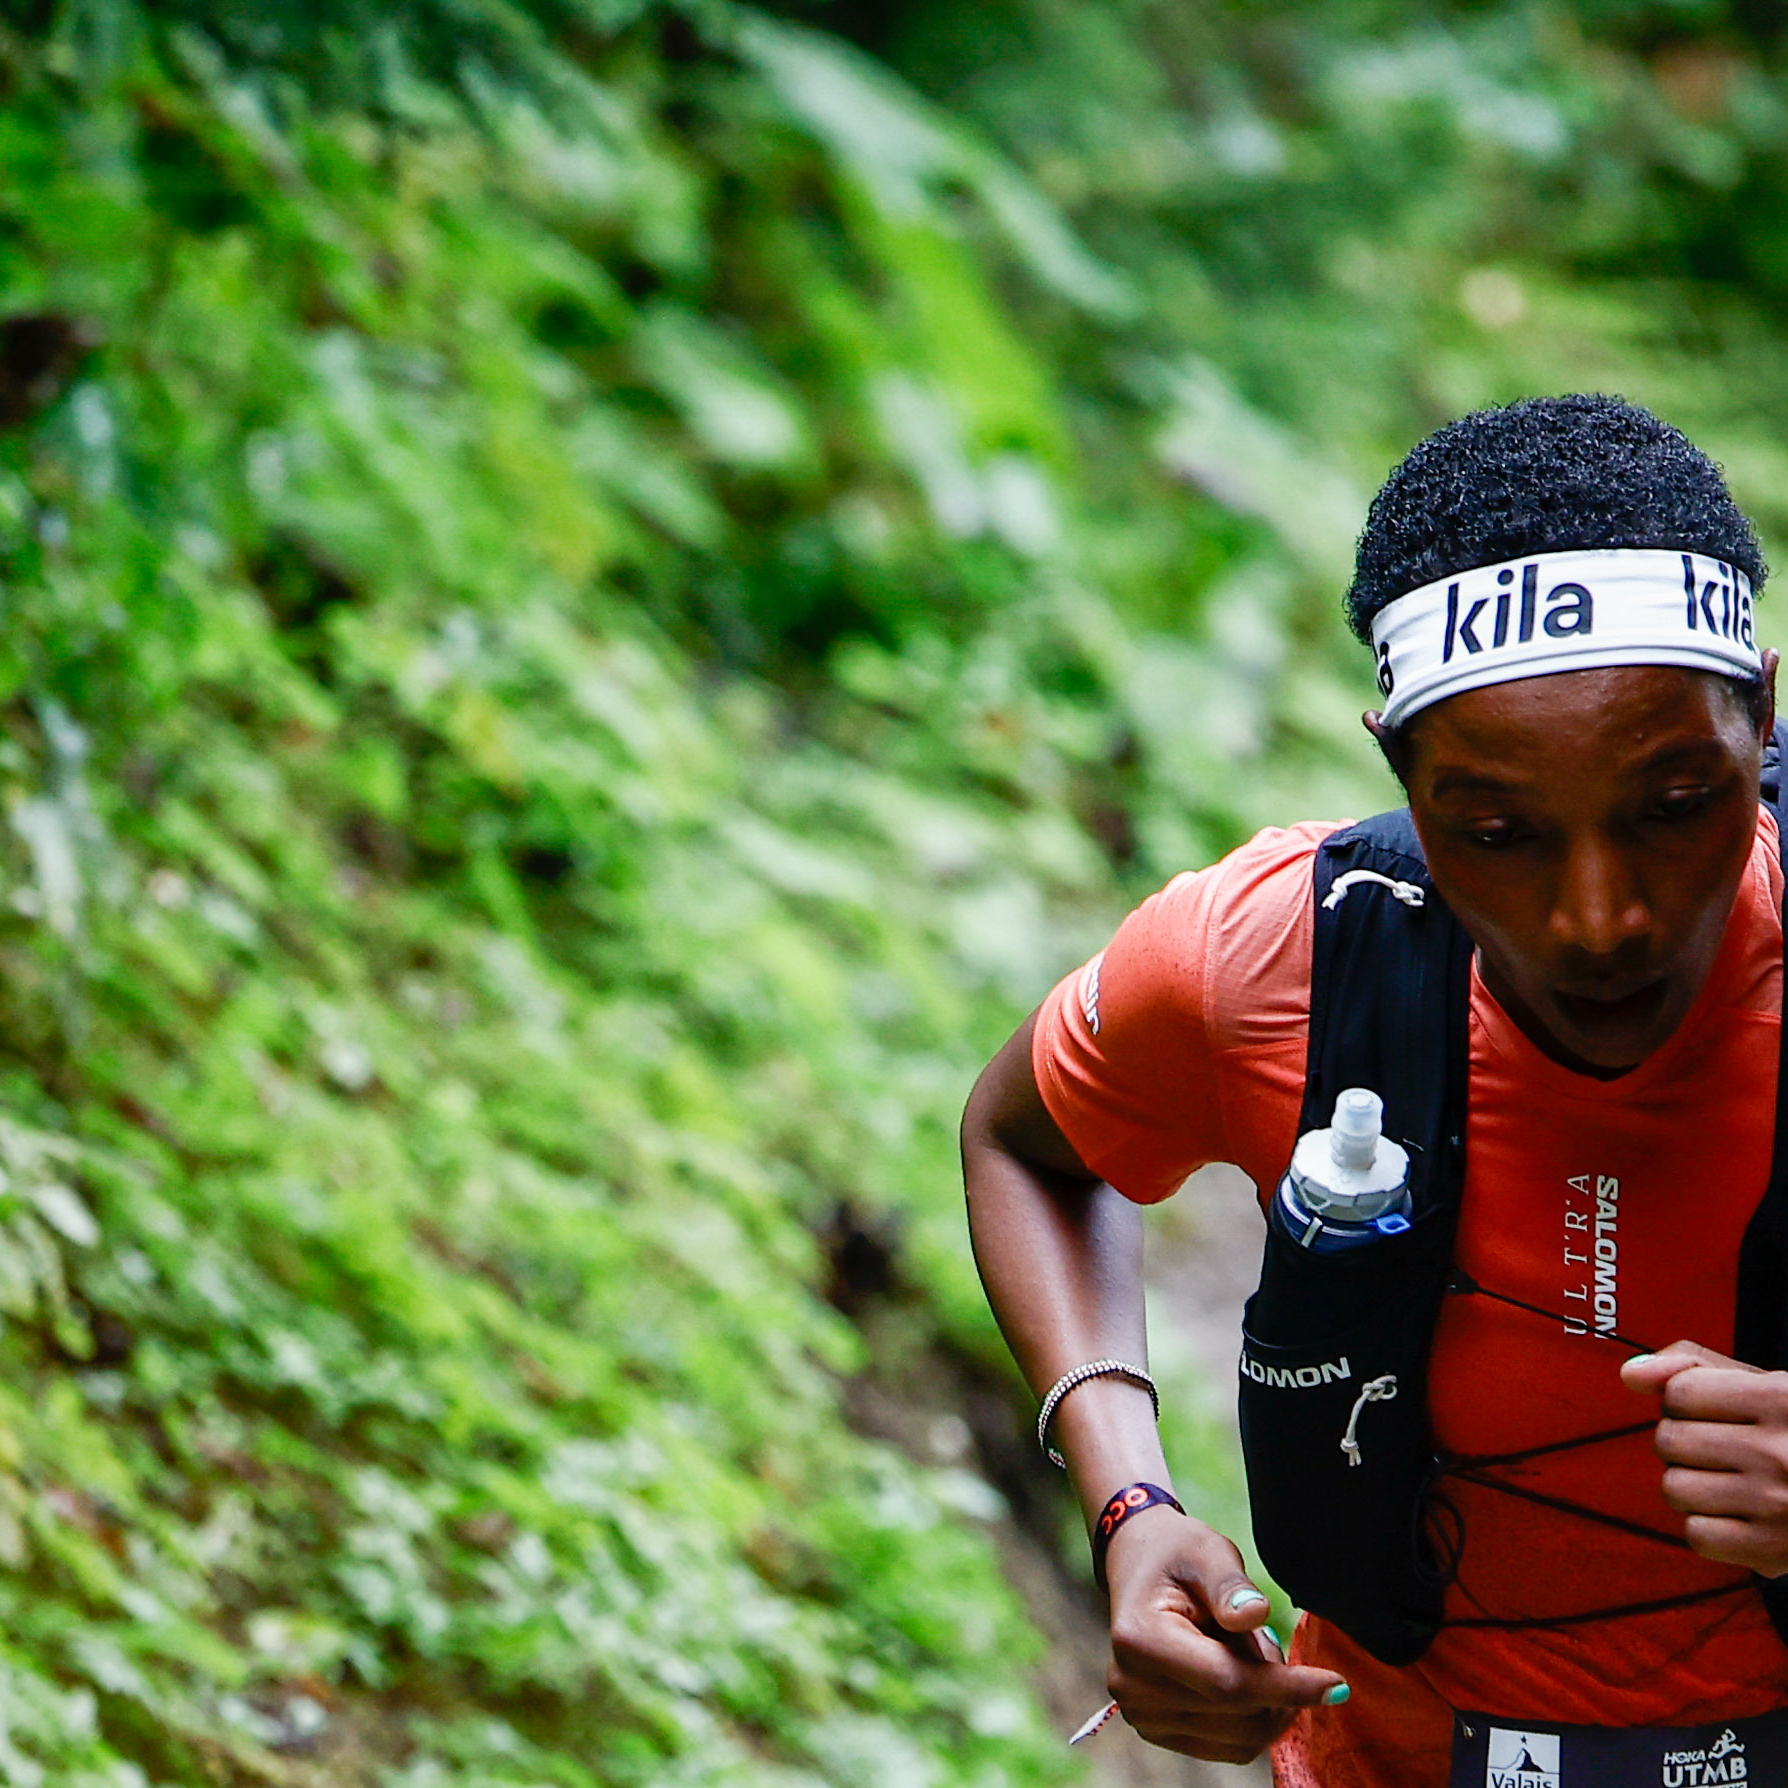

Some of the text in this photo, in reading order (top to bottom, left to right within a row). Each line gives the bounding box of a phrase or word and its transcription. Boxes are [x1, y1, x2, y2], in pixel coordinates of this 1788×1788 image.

[1443, 563, 1594, 664] kila
[1681, 554, 1757, 656] kila
[1594, 1174, 1619, 1340] SALOMON
[1662, 1756, 1748, 1788] UTMB
[1663, 1749, 1707, 1766] HOKA
